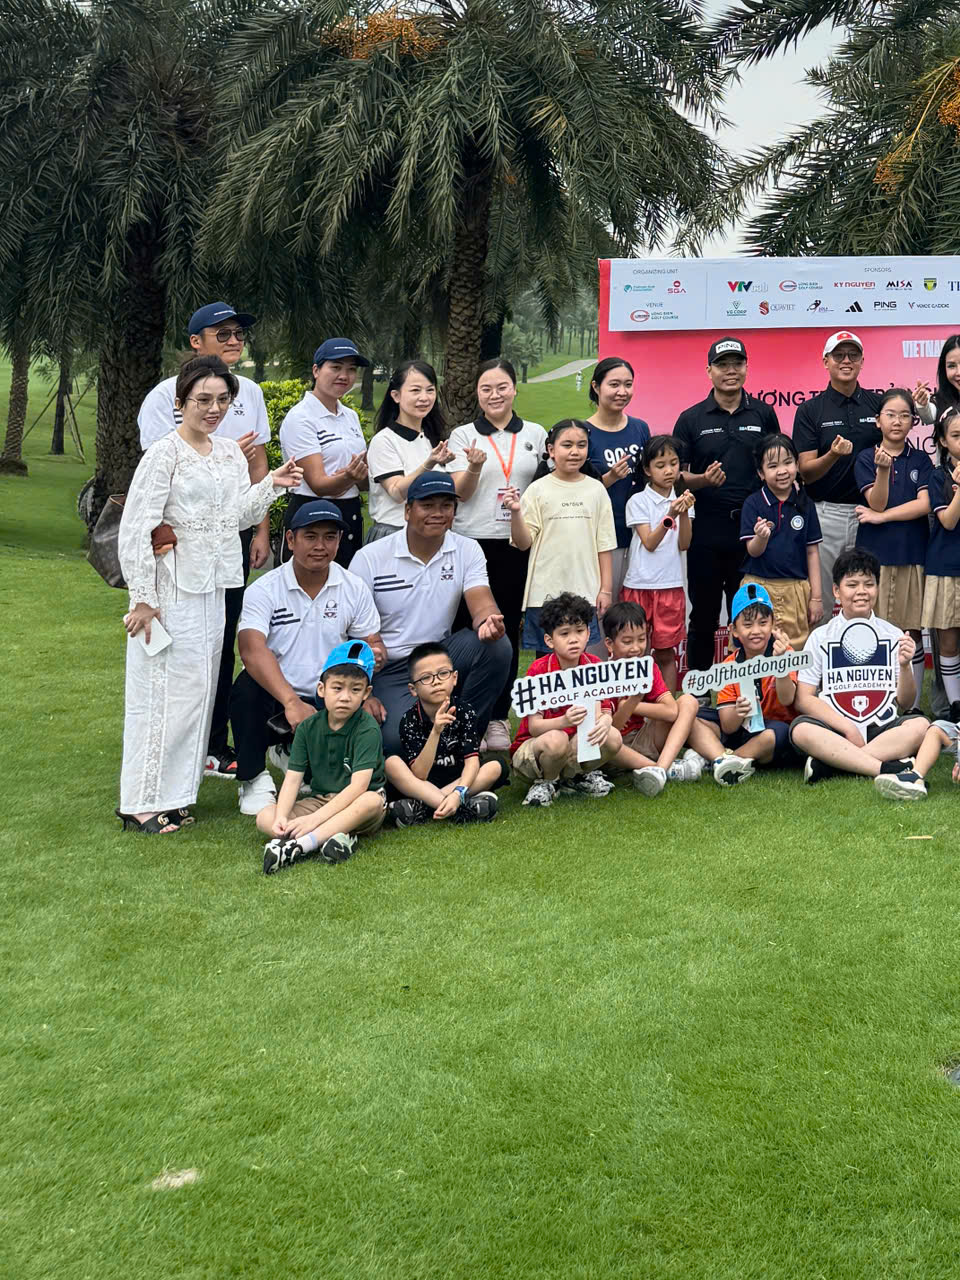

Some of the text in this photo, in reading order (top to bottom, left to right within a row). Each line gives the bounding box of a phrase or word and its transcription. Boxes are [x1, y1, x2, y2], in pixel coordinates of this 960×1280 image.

[886, 280, 913, 288] MISA
[902, 339, 946, 358] VIETNA
[571, 659, 648, 689] NGUYEN
[687, 654, 809, 691] #golfthatdongian
[828, 668, 893, 685] HA NGUYEN
[550, 683, 639, 705] GOLF ACADEMY
[833, 683, 852, 691] GOLF
